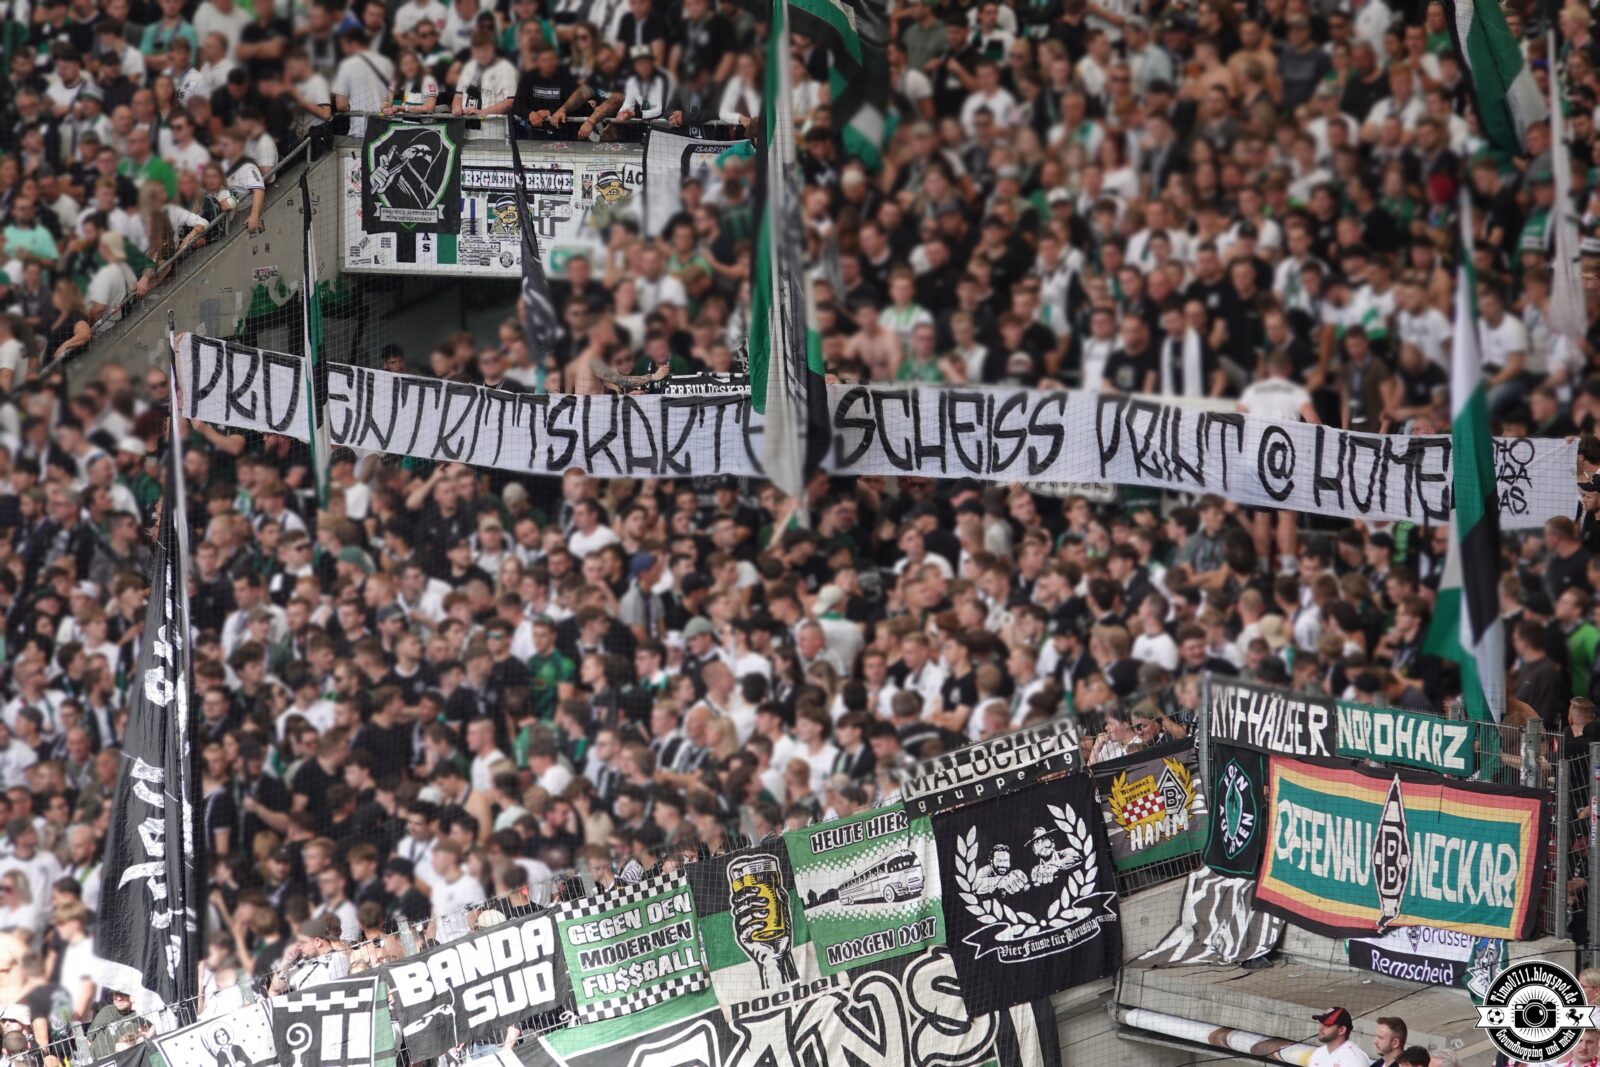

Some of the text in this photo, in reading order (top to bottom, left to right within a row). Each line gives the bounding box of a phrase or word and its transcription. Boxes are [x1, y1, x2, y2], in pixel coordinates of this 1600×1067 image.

[191, 335, 301, 432] PRO
[834, 386, 1069, 476] SCHEISS
[1096, 393, 1245, 492] PRINT
[1258, 425, 1296, 502] @
[1314, 424, 1452, 520] HOME
[902, 719, 1079, 799] MALOCHER
[1337, 705, 1468, 770] NORDHARZ
[918, 771, 1026, 813] gruppe
[810, 810, 909, 854] HEUTE HIER
[1130, 808, 1189, 851] HAMM
[1276, 799, 1372, 886] OFFENAU
[1411, 832, 1518, 908] NECKAR
[567, 892, 692, 945] GEGEN DEN
[826, 917, 937, 966] MORGEN DORT
[389, 916, 555, 1007] BANDA
[577, 919, 694, 972] MODERNEN
[1371, 949, 1454, 986] Remscheid
[462, 960, 556, 1029] SUD
[581, 947, 701, 999] FU$$BALL
[731, 974, 841, 1020] poebel
